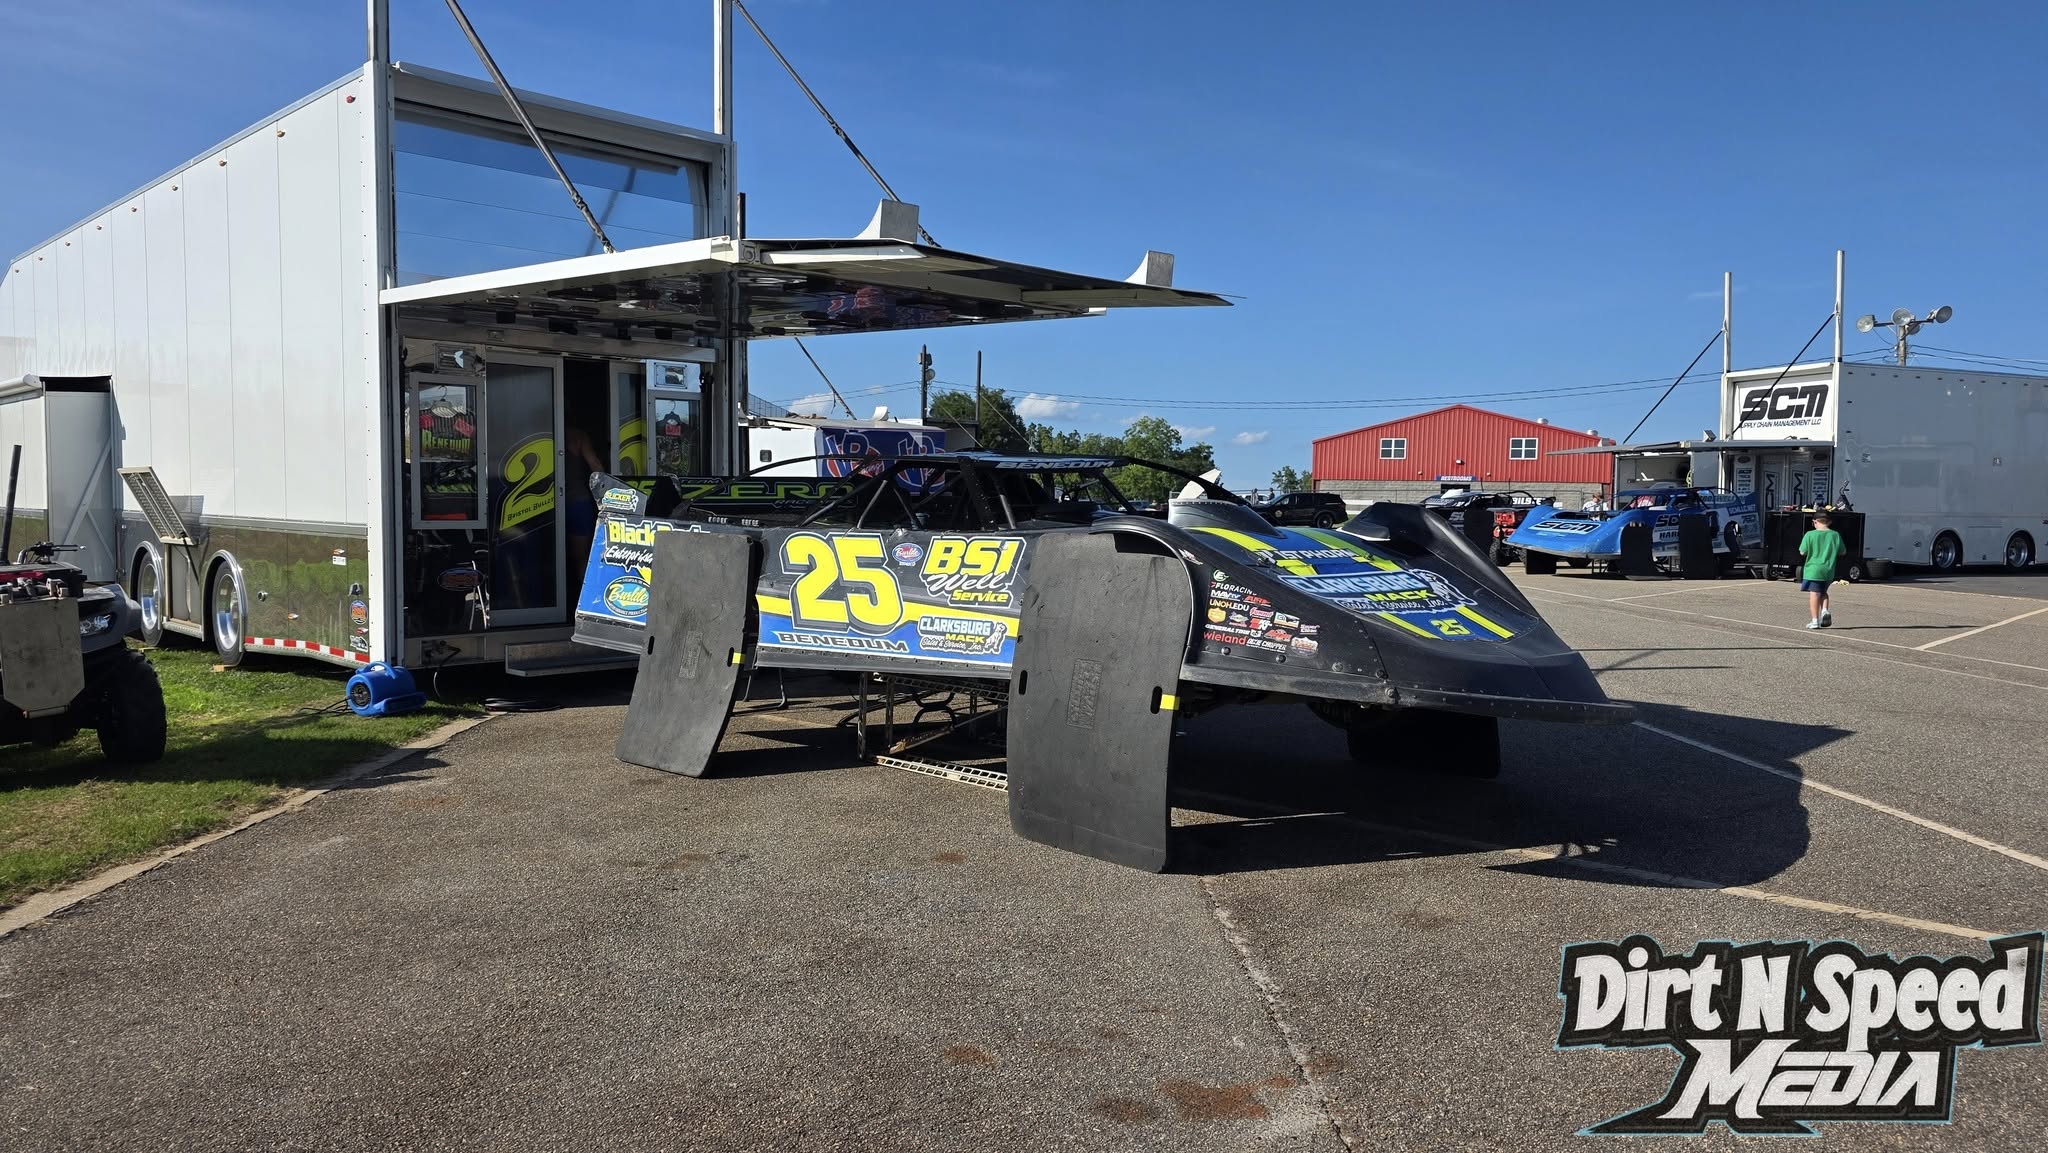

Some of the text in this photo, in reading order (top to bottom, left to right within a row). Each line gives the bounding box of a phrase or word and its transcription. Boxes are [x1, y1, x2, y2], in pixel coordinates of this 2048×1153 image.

[1740, 384, 1829, 421] SCM
[1737, 421, 1756, 429] UPPLY
[1773, 419, 1810, 427] MANAGEMENT
[995, 461, 1114, 469] BENEDUM
[682, 483, 854, 500] ZERO
[608, 520, 657, 547] Black
[1535, 520, 1600, 533] SCM
[923, 539, 1020, 576] BSI
[785, 535, 902, 626] 25
[926, 572, 1006, 592] Well
[1293, 573, 1429, 593] CLARKSBURG
[951, 589, 1009, 602] Service
[1364, 590, 1437, 601] MACK
[920, 618, 992, 635] CLARKSBURG
[1431, 619, 1470, 635] 25
[777, 632, 909, 652] BENEDUM
[945, 633, 985, 643] MACK
[1204, 632, 1247, 645] wieland
